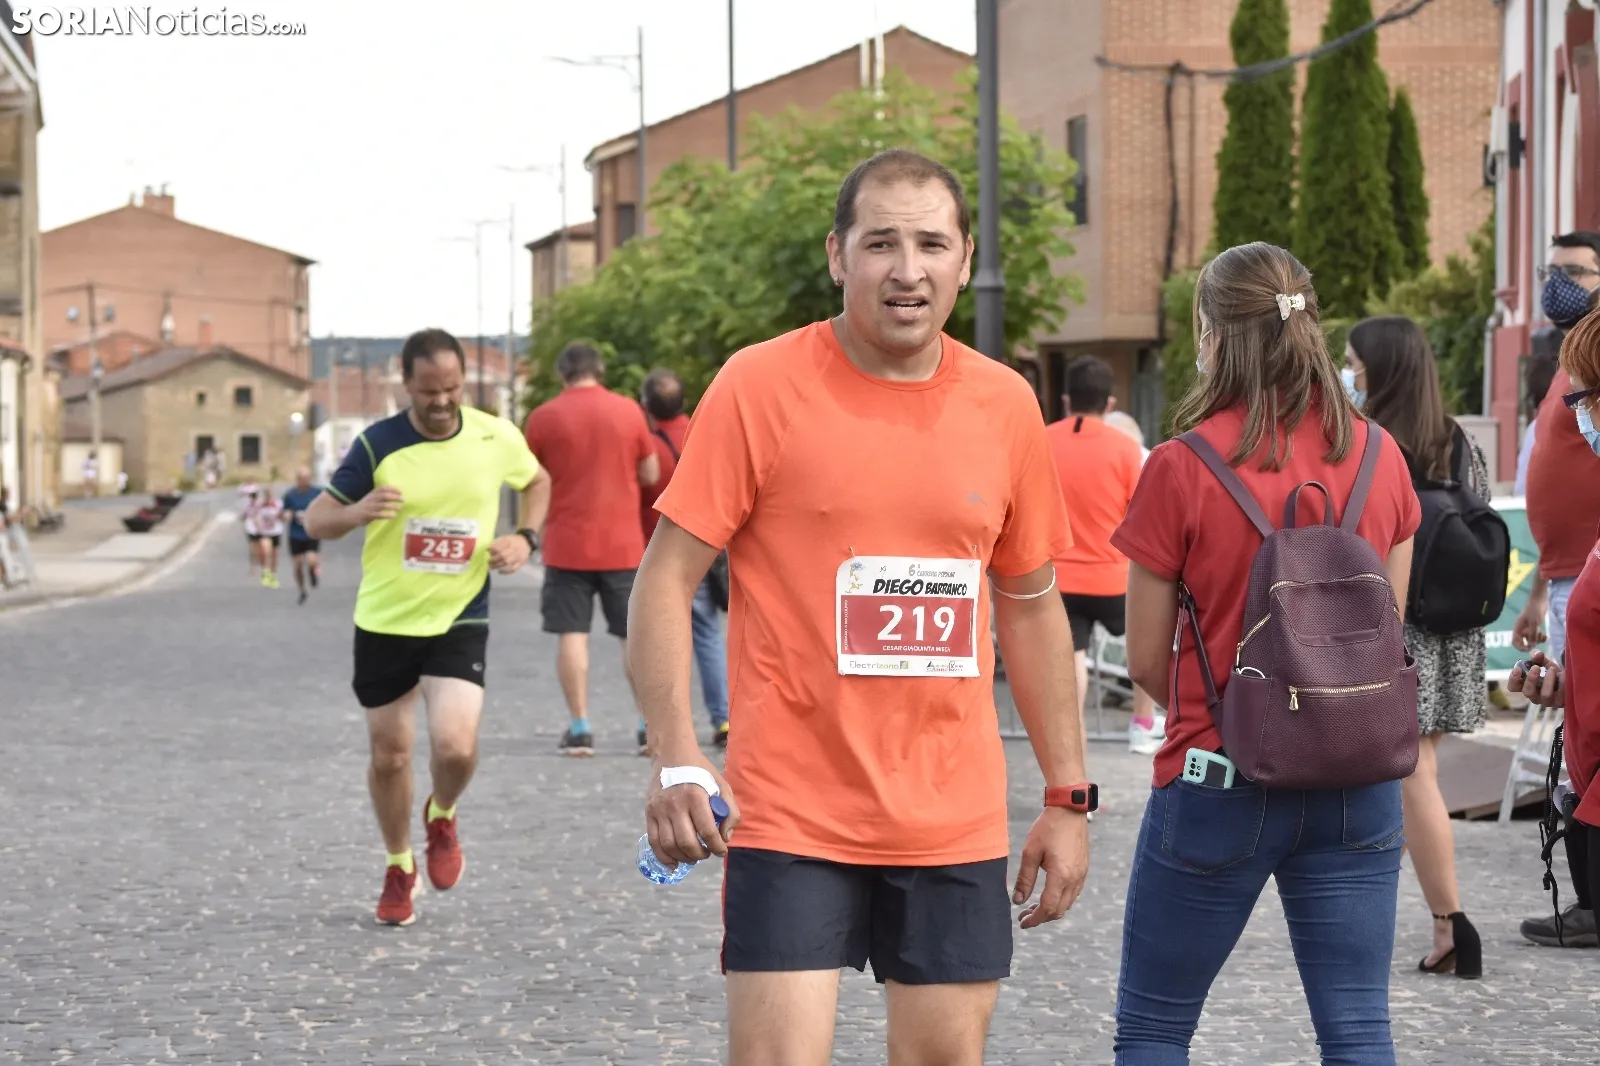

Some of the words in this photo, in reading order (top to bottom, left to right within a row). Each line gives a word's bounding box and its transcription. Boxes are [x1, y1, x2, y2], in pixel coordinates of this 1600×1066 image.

[421, 538, 465, 559] 243
[872, 578, 925, 596] DIEGO
[925, 582, 968, 597] BARRANCO
[877, 604, 956, 642] 219
